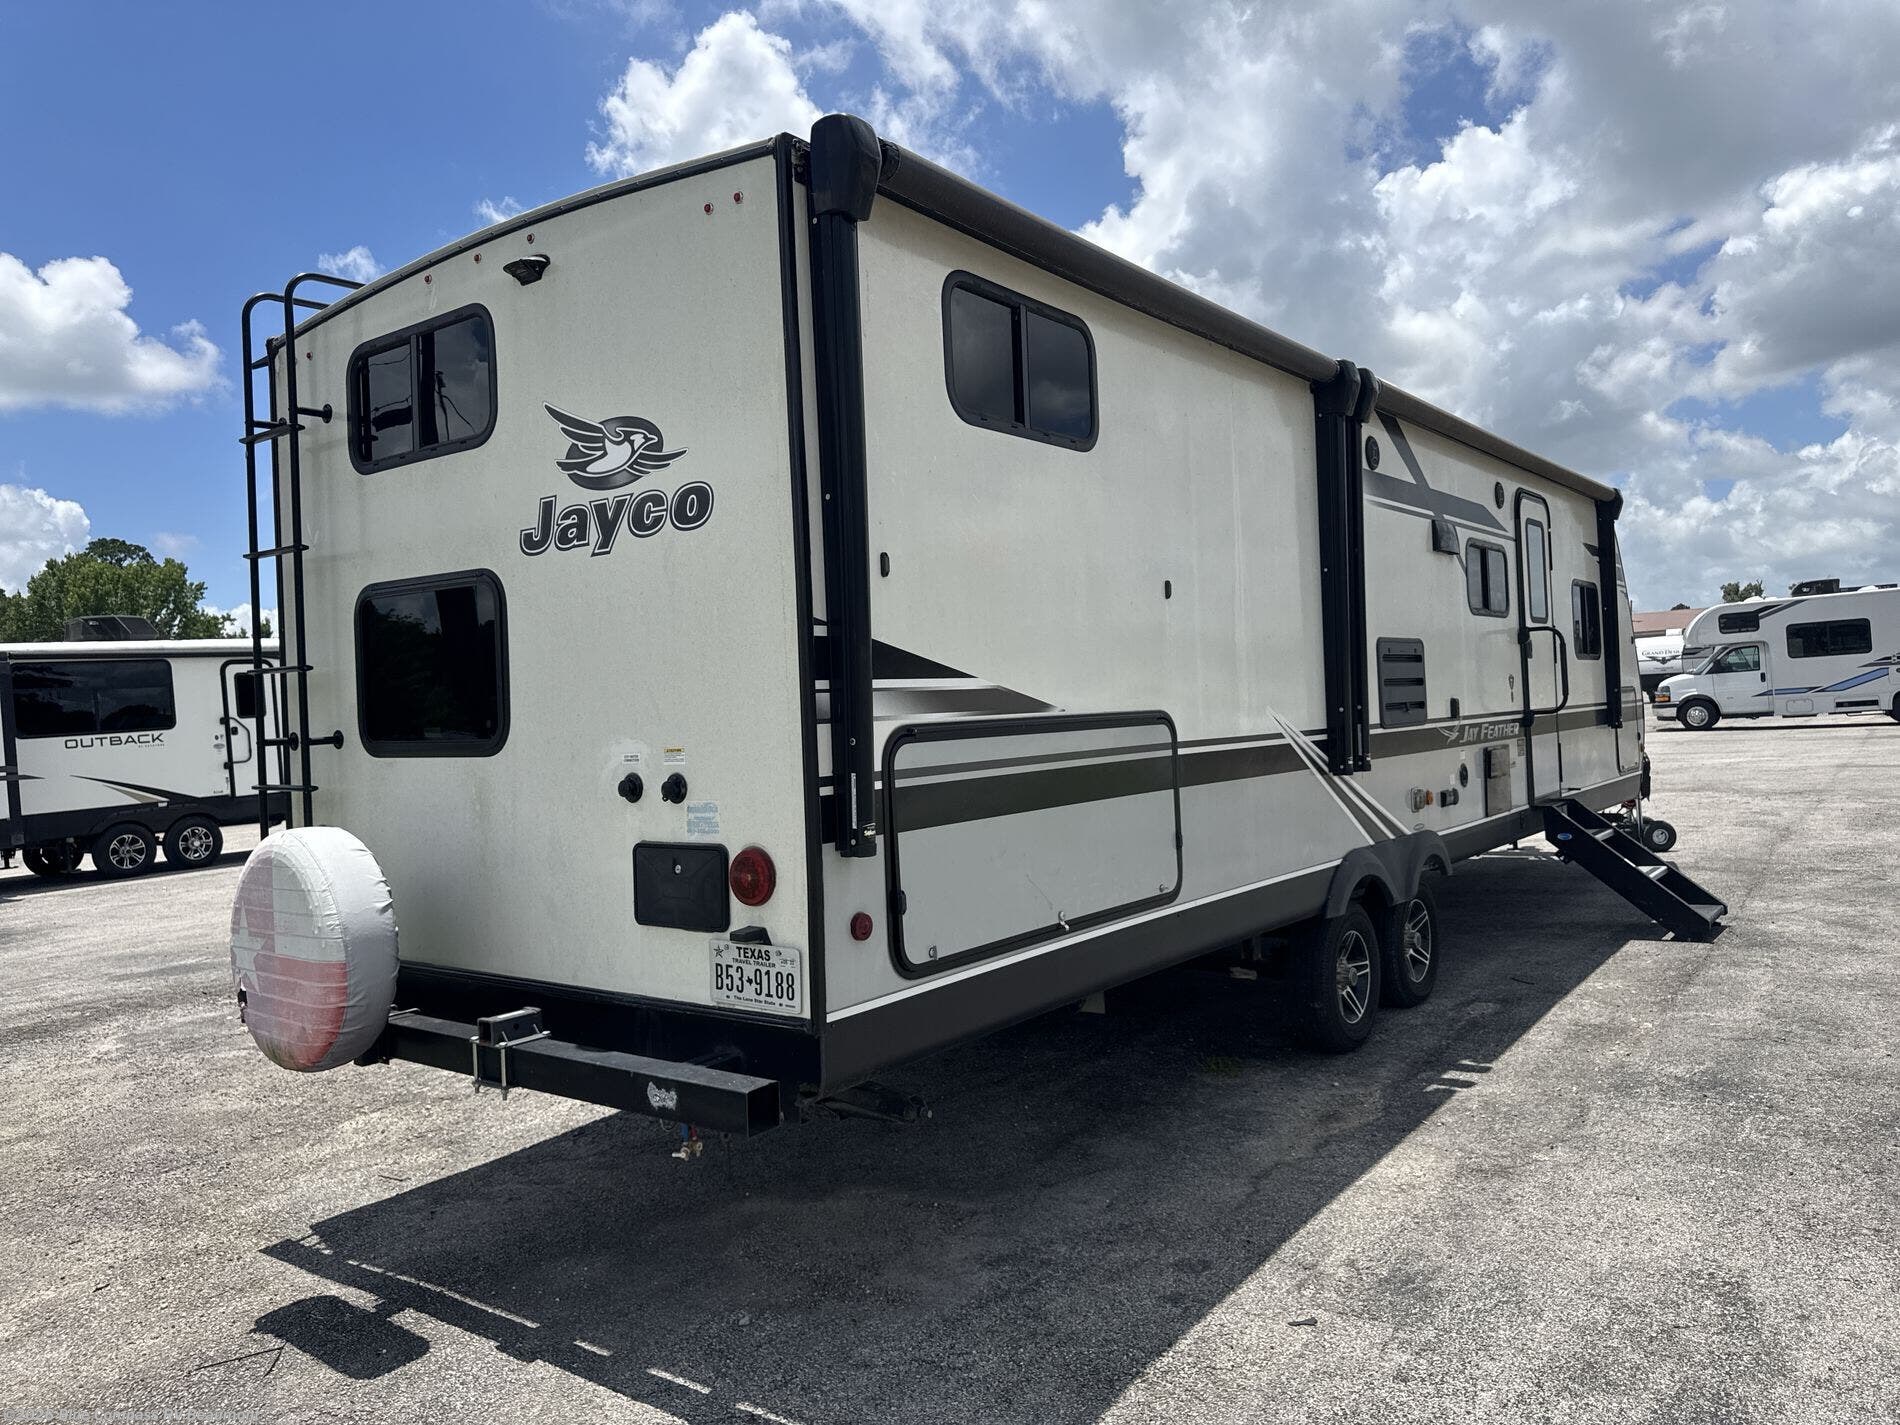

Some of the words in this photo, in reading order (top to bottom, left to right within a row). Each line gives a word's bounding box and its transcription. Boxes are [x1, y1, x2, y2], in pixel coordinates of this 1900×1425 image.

[519, 480, 714, 557] Jayco
[64, 732, 164, 749] OUTBACK
[1460, 725, 1480, 743] JAY
[1481, 722, 1520, 740] FEATHER
[735, 946, 771, 962] TEXAS
[732, 957, 752, 966] TRAVEL
[753, 959, 776, 969] TRAILER
